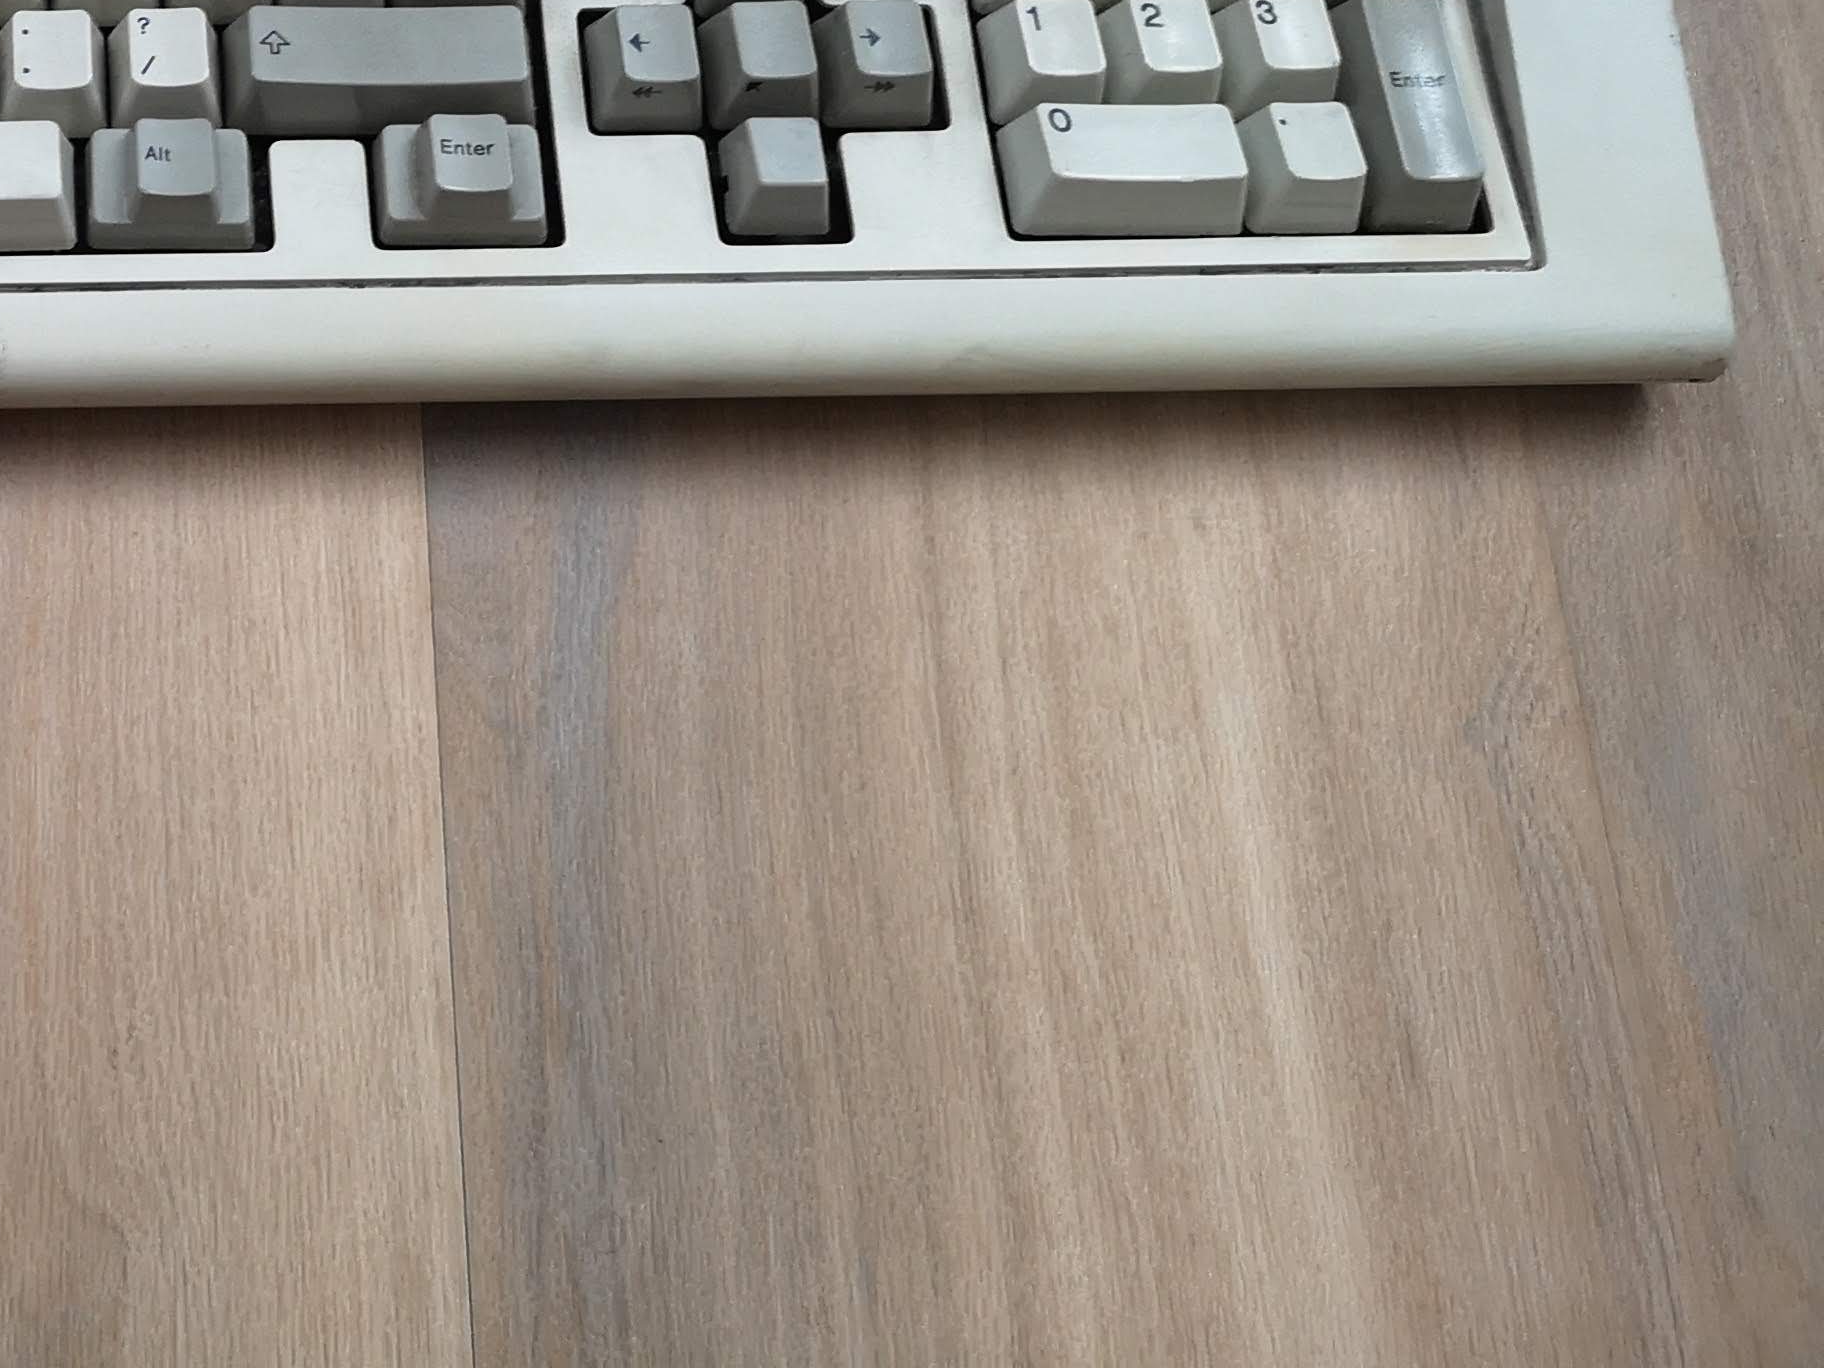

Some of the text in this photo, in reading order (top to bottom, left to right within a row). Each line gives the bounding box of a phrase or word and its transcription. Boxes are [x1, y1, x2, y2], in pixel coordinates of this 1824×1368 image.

[1025, 6, 1042, 31] 1
[1140, 2, 1164, 28] 2
[1255, 0, 1278, 25] 3
[1387, 70, 1446, 89] Enter
[1047, 107, 1073, 133] 0
[144, 145, 171, 162] Alt
[440, 138, 496, 156] Enter
